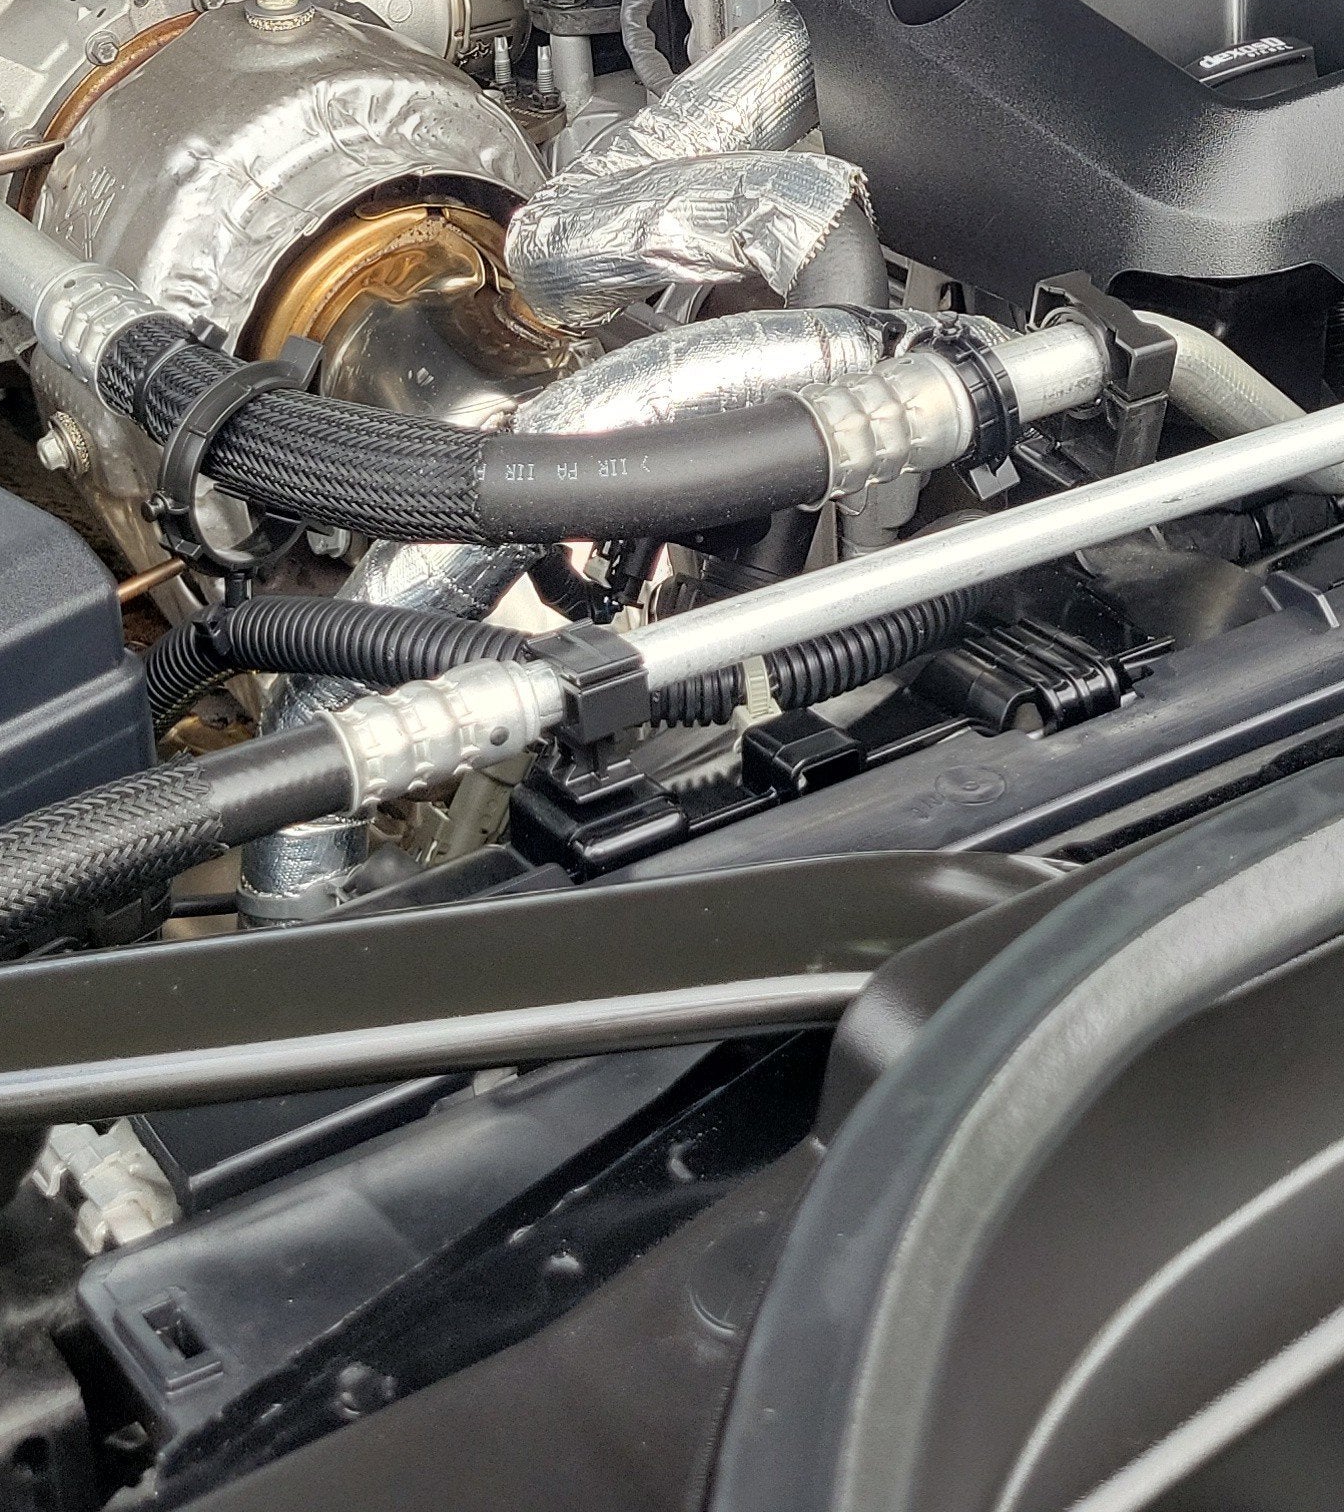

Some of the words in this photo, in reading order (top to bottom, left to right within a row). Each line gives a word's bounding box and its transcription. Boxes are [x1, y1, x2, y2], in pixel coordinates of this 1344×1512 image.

[505, 464, 535, 481] IIR
[557, 462, 578, 480] PA
[598, 458, 628, 477] IIR
